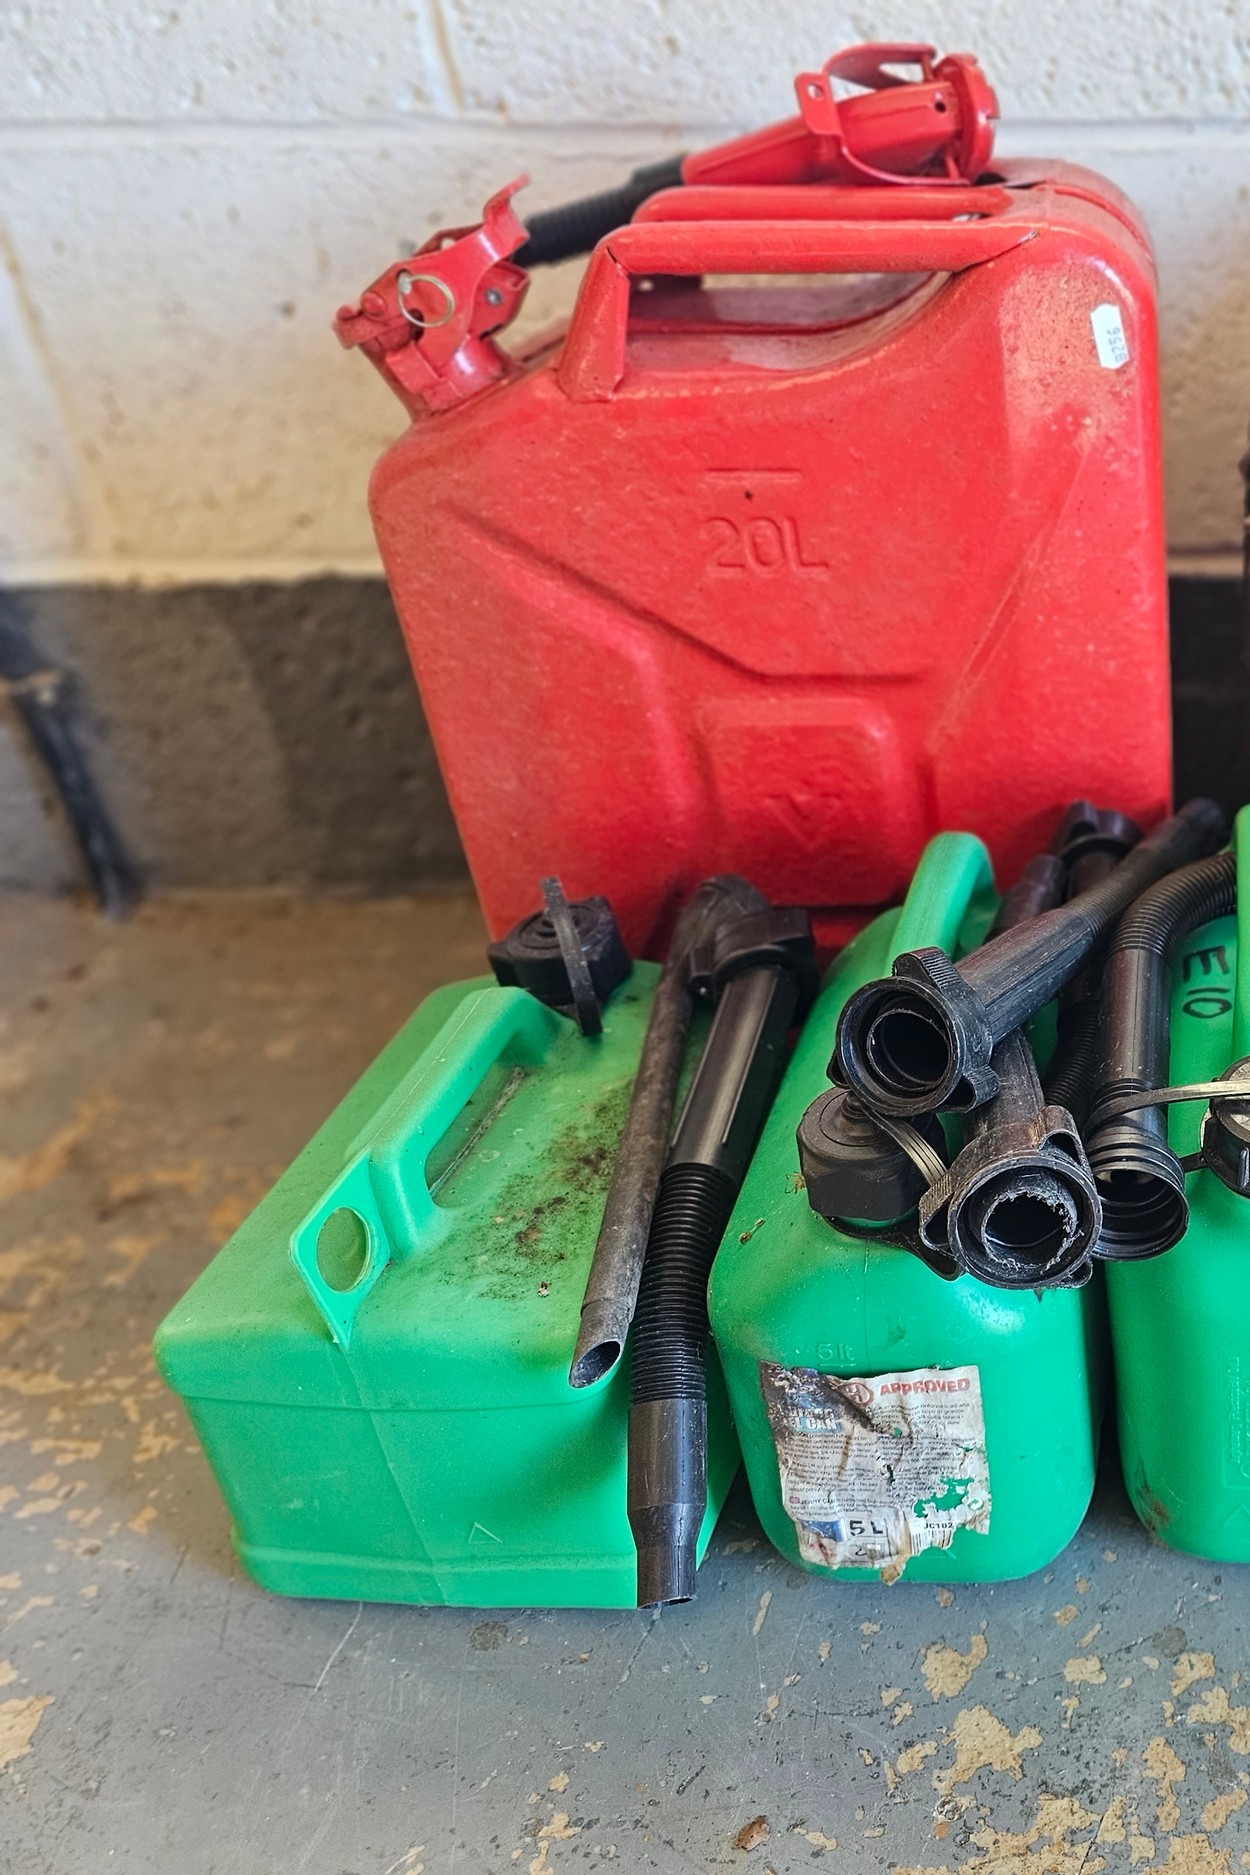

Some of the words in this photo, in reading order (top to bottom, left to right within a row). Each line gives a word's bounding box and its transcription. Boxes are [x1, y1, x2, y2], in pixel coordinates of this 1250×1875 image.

[707, 515, 829, 575] 20L
[1181, 943, 1233, 1020] E10
[879, 1377, 971, 1397] APPROVED
[849, 1520, 865, 1537] 5
[870, 1520, 884, 1536] L
